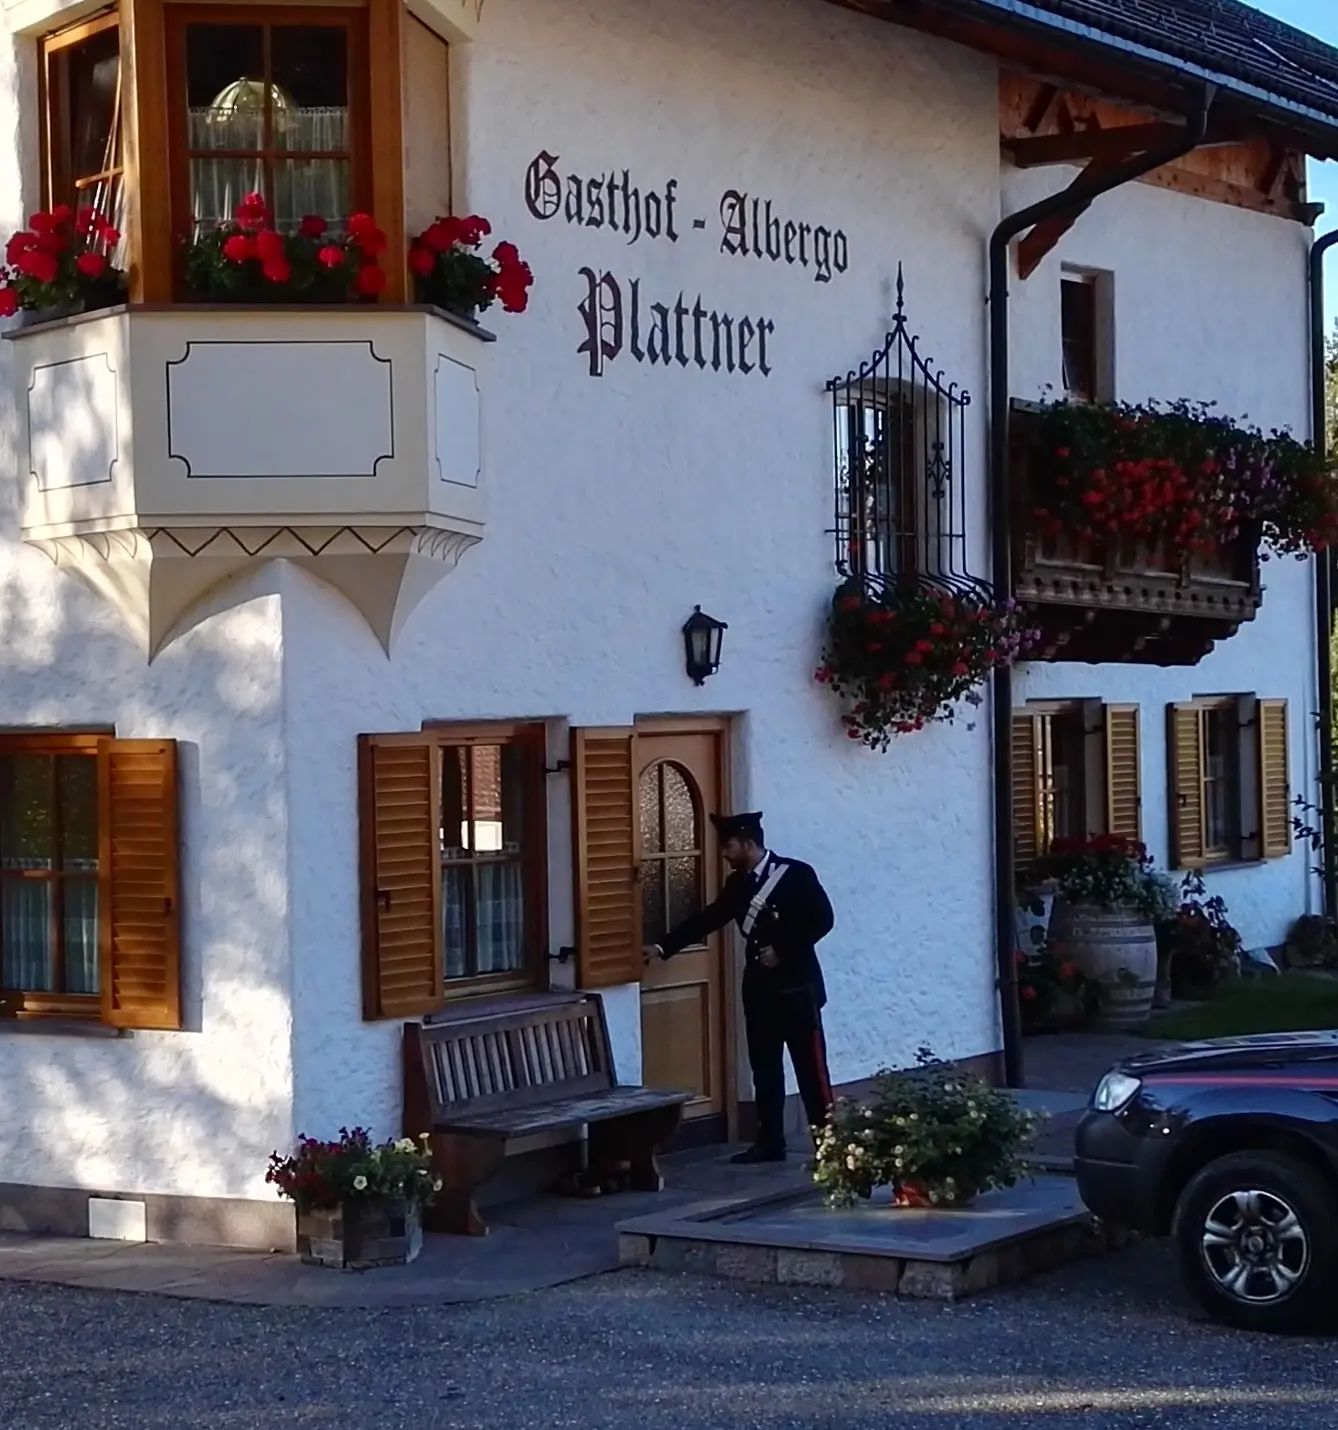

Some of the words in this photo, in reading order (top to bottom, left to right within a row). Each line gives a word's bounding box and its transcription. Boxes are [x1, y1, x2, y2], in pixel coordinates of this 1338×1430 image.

[524, 149, 680, 246] Gasthof
[719, 189, 849, 283] Albergo
[577, 266, 776, 377] Plattner
